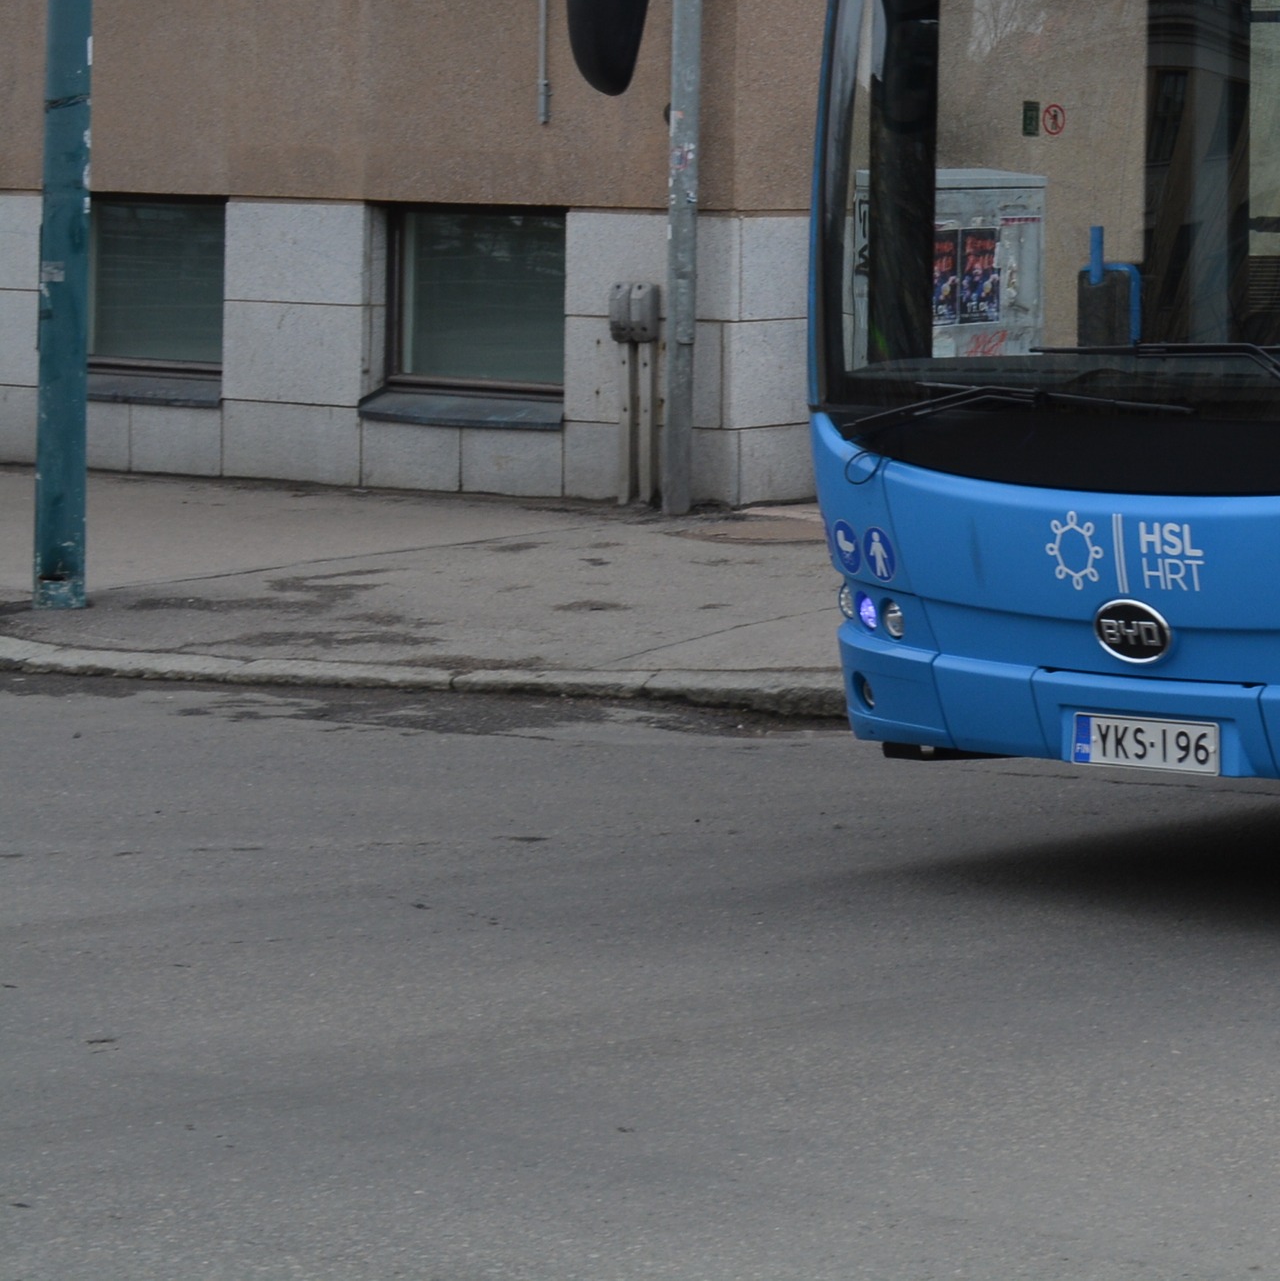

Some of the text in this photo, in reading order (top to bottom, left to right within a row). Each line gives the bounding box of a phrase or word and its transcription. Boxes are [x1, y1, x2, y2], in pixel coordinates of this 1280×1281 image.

[1139, 522, 1204, 557] HSL
[1142, 557, 1205, 592] HRT
[1100, 619, 1162, 647] BYD
[1096, 723, 1210, 766] YKS-196
